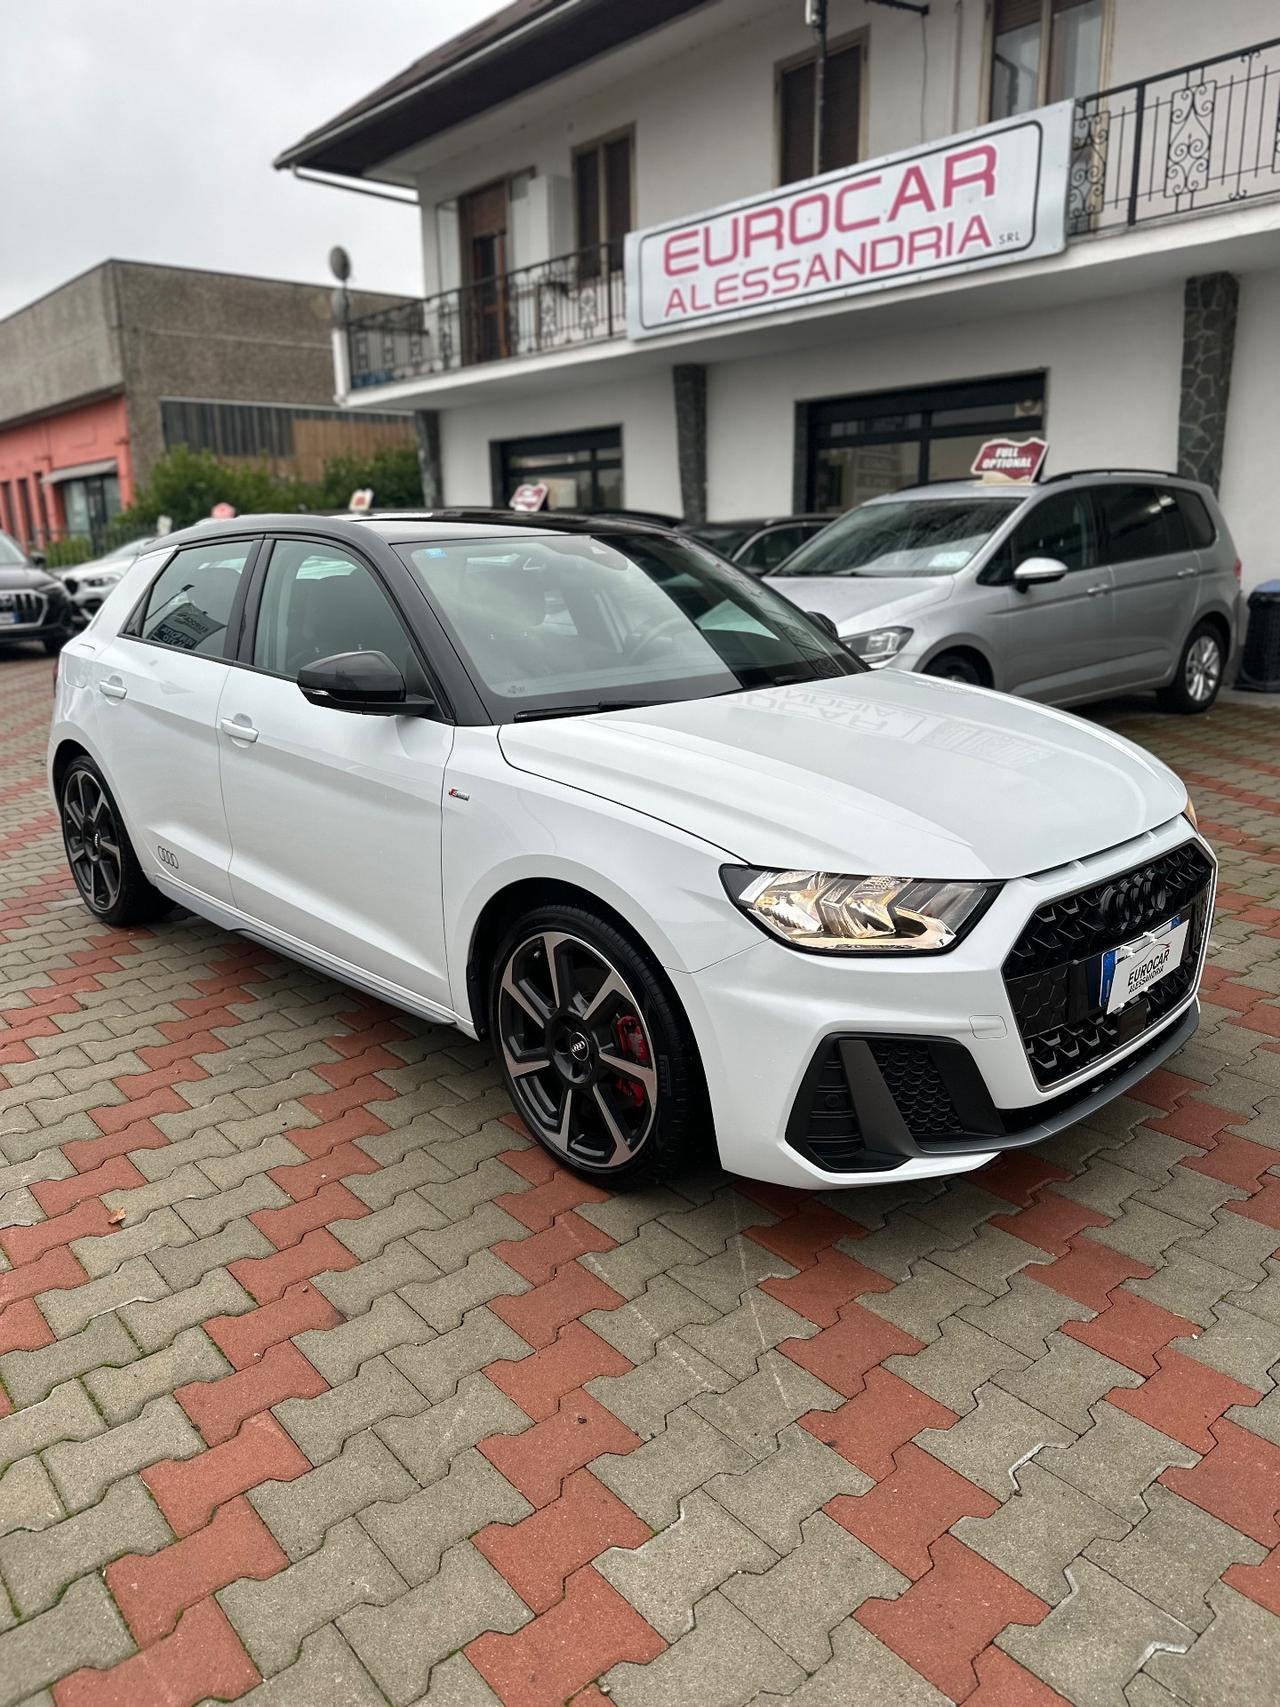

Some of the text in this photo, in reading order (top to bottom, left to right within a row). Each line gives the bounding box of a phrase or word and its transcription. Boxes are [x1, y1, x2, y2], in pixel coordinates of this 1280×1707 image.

[663, 144, 998, 277] EUROCAR
[664, 214, 1021, 318] ALESSANDRIA SRL
[982, 457, 1032, 469] OPTIONAL
[995, 447, 1018, 458] FULL
[1127, 949, 1170, 987] EUROCAR
